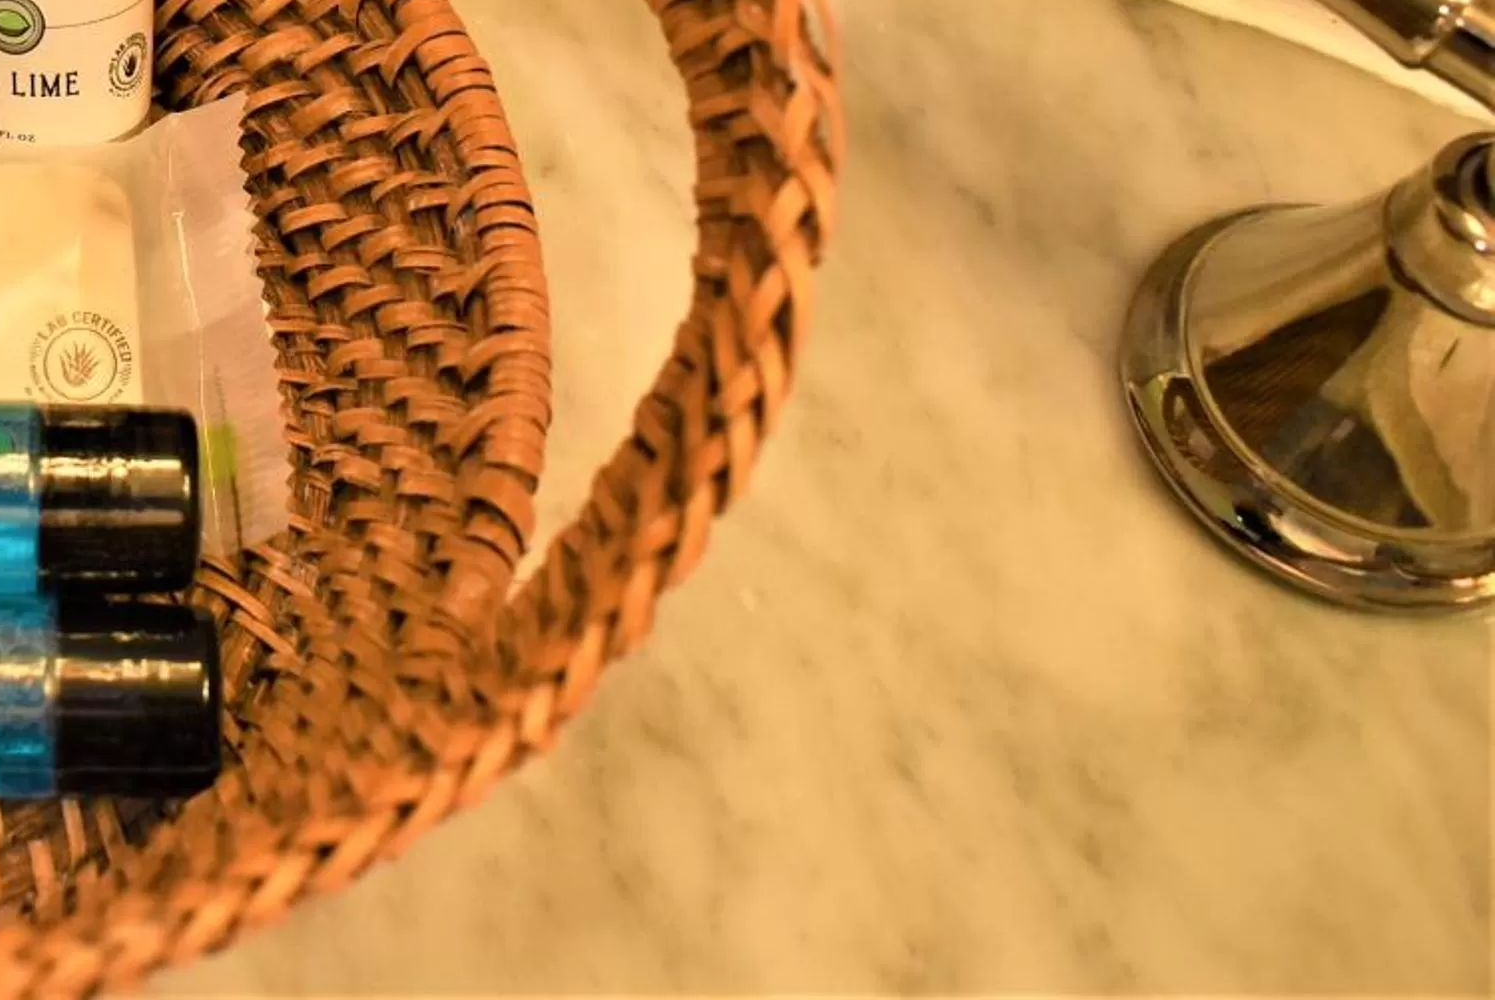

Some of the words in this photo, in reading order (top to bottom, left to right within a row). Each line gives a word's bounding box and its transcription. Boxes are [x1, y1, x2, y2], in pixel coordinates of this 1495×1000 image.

[12, 70, 81, 99] LIME
[36, 313, 68, 341] LAB
[72, 310, 133, 363] CERTIFIED
